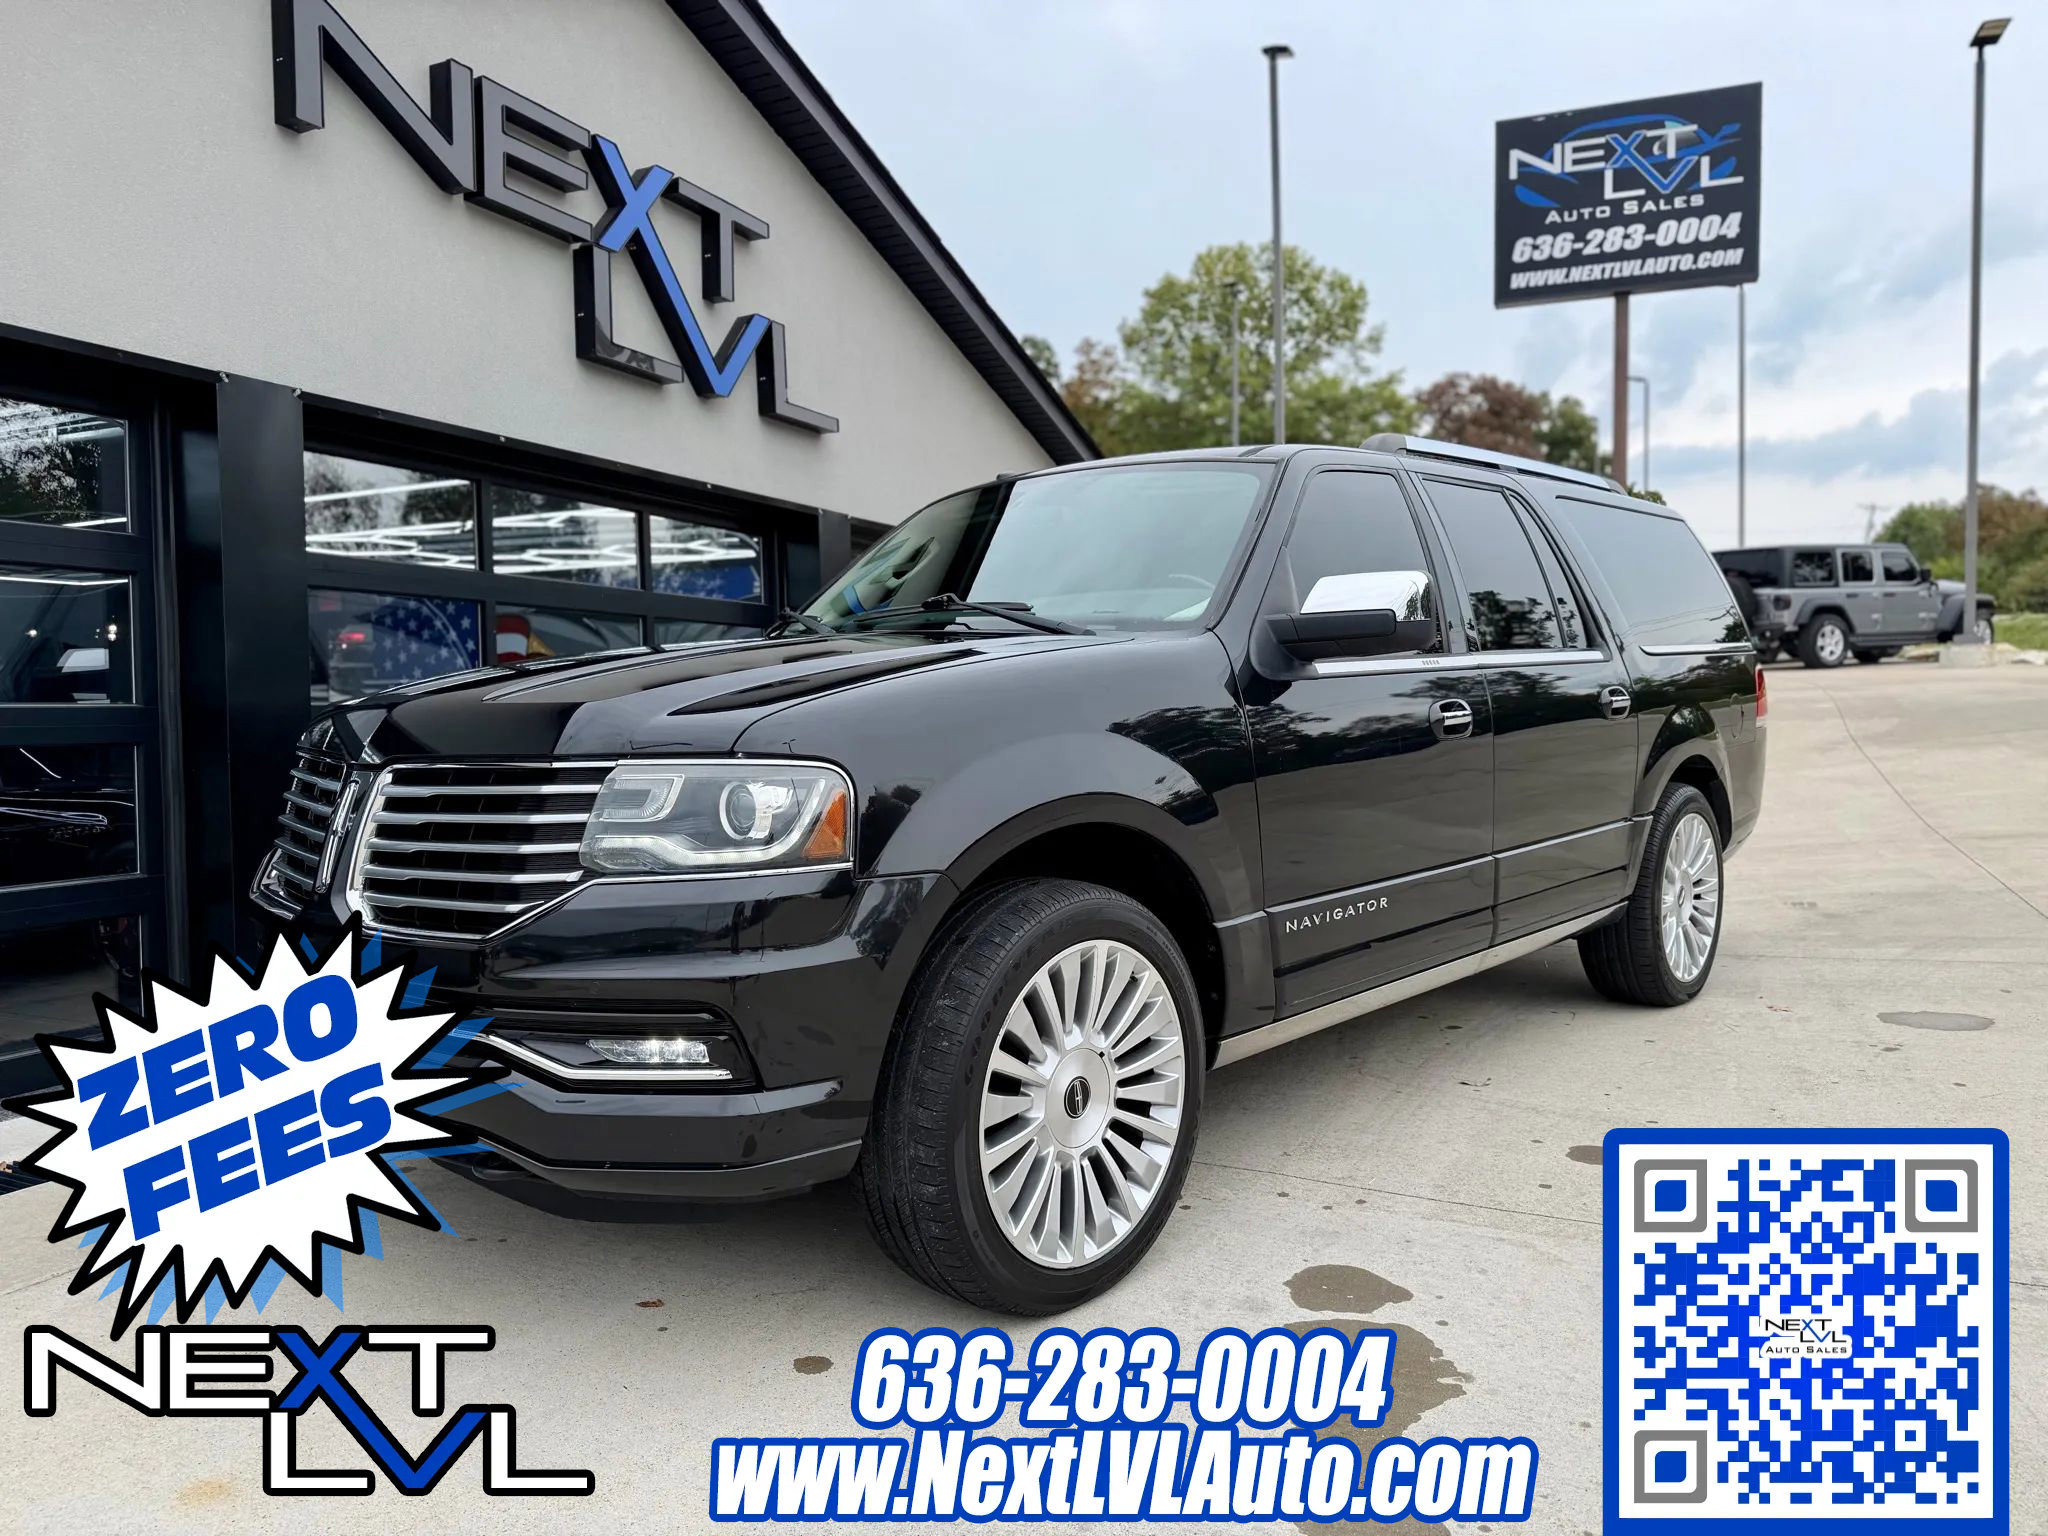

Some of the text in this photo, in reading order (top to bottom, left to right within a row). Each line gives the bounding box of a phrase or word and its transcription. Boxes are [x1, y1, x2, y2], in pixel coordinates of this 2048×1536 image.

[271, 0, 769, 303] NEXT
[1508, 123, 1699, 181] NEXT
[1603, 154, 1745, 201] LVL
[1544, 193, 1705, 225] AUTO SALES
[1511, 211, 1743, 264] 636-283-0004
[1509, 247, 1745, 291] WWW.NEXTLVLAUTO.COM
[573, 240, 839, 433] LVL
[1285, 897, 1389, 933] NAVIGATOR
